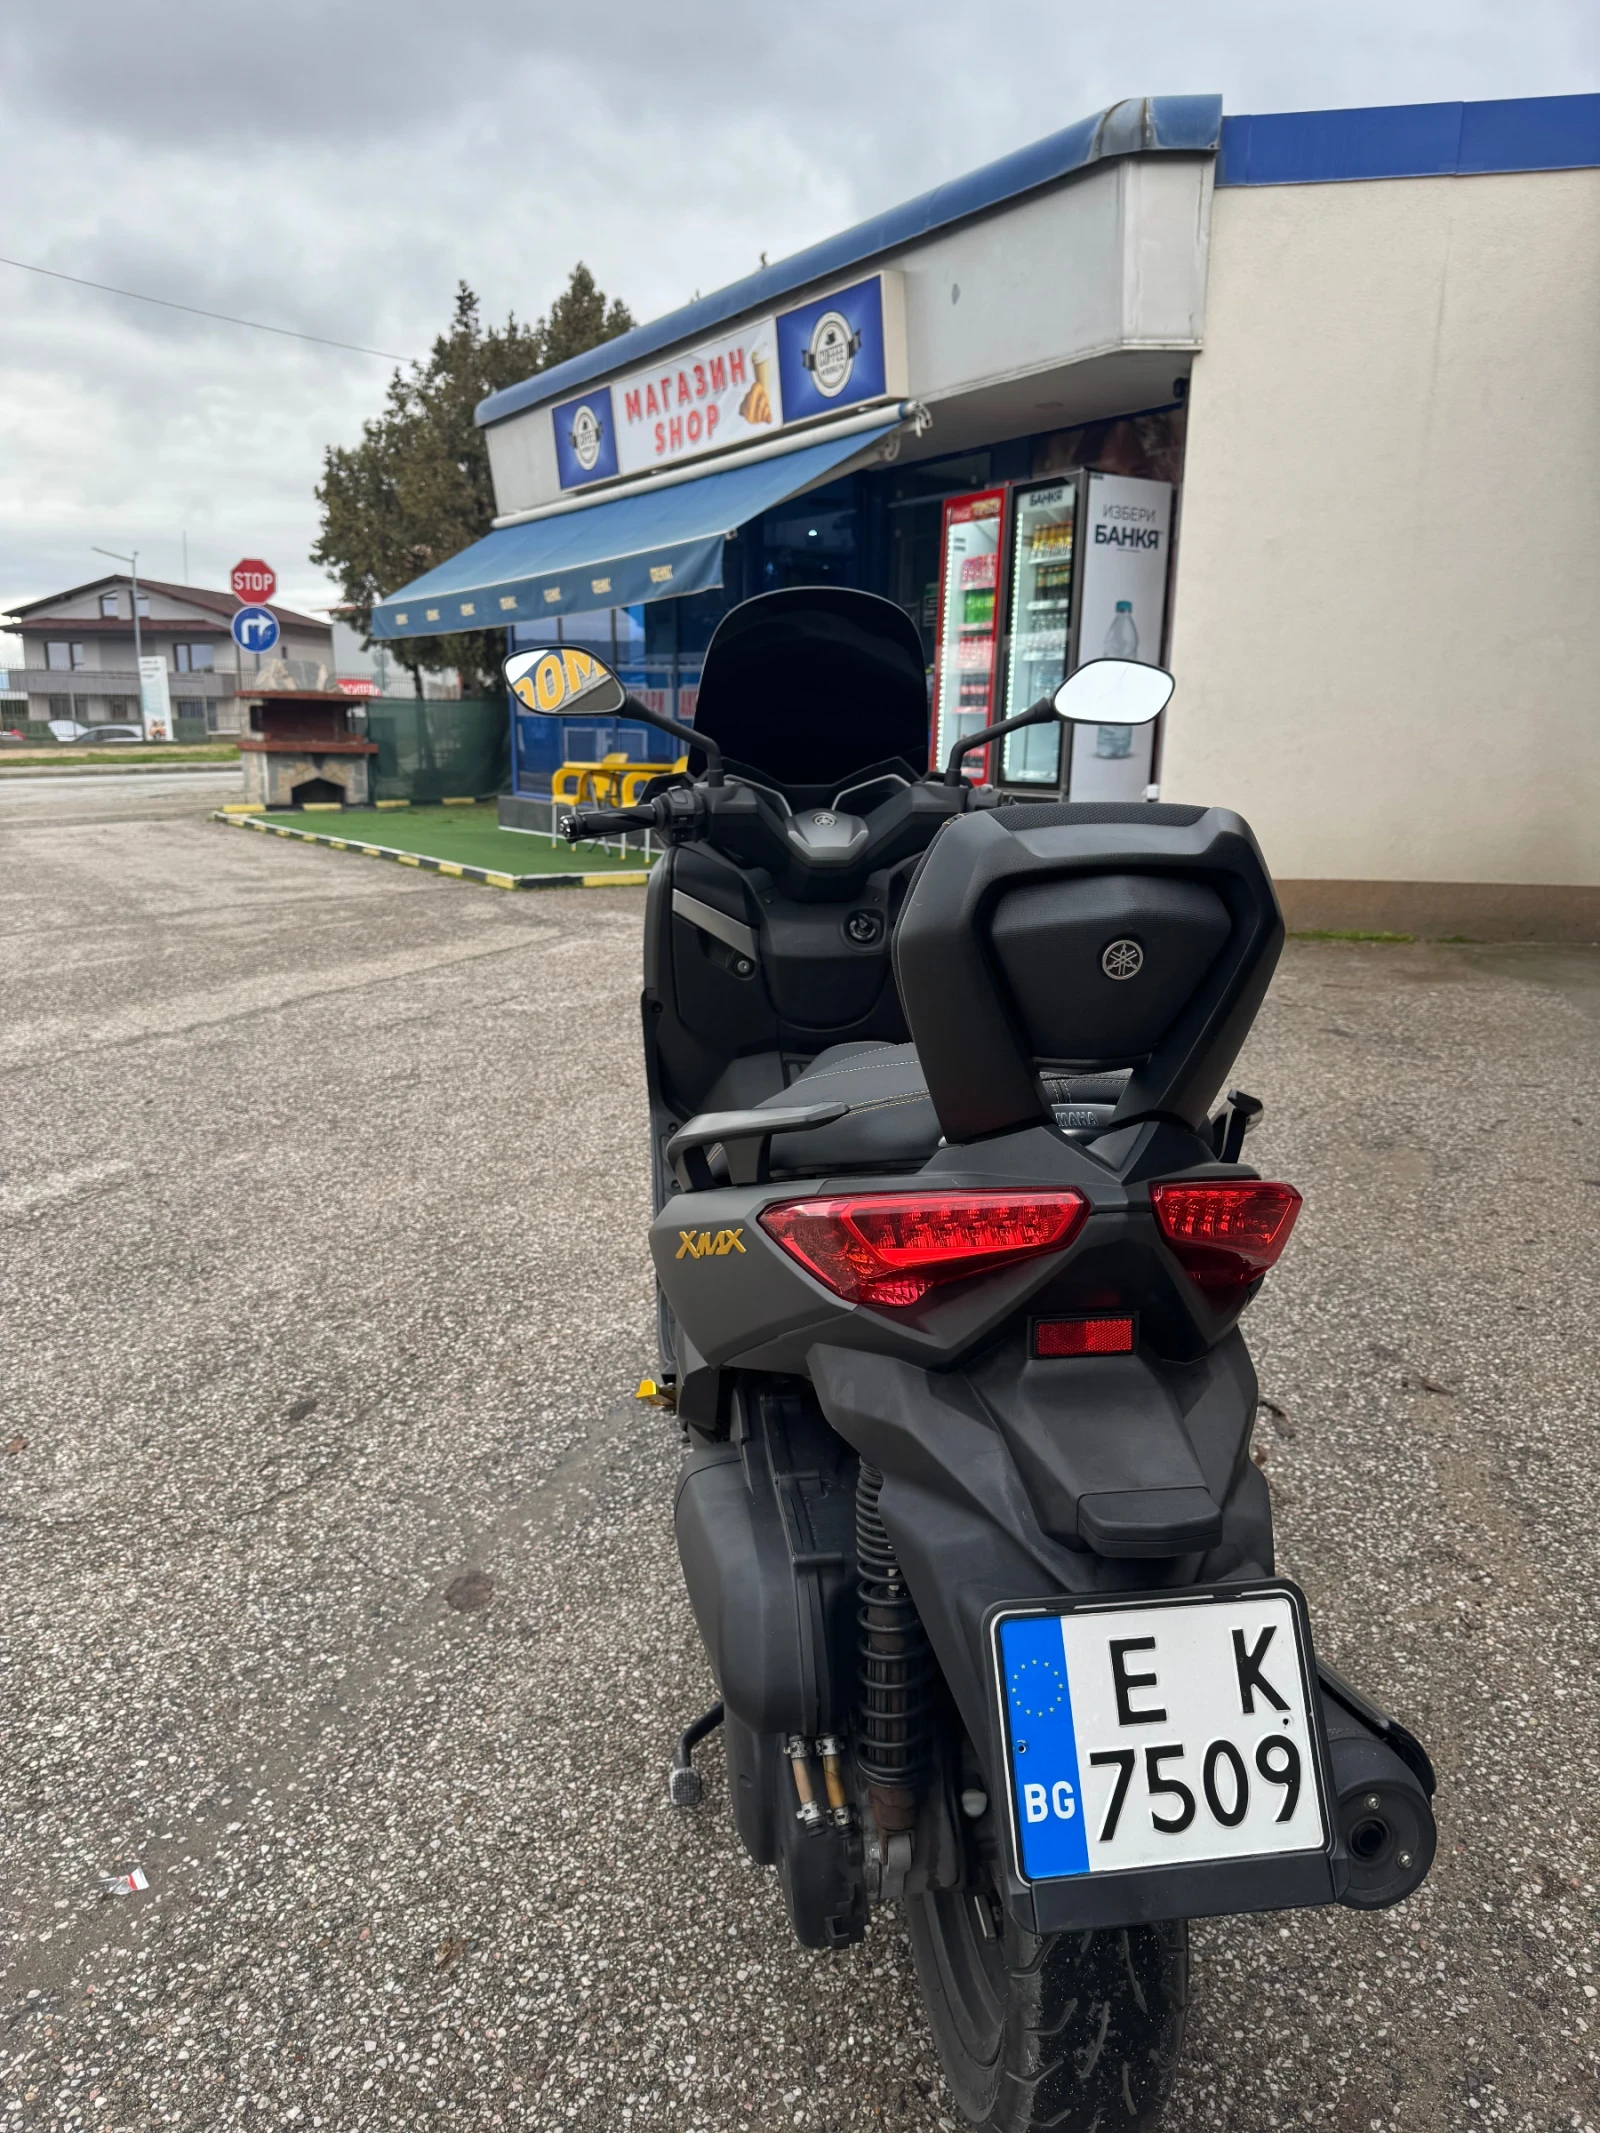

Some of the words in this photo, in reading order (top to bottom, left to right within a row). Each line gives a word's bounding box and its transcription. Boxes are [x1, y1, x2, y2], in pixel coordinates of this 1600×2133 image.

[624, 347, 746, 422] МАГАЗИН
[654, 403, 719, 454] SHOP
[1030, 489, 1063, 507] БАНКЯ
[1103, 504, 1157, 523] ИЗБЕРИ
[1094, 524, 1159, 550] БАНКЯ
[233, 572, 274, 592] STOP
[1108, 1635, 1168, 1727] E
[1230, 1625, 1291, 1715] K
[1023, 1780, 1076, 1824] BG
[1088, 1734, 1303, 1843] 7509
